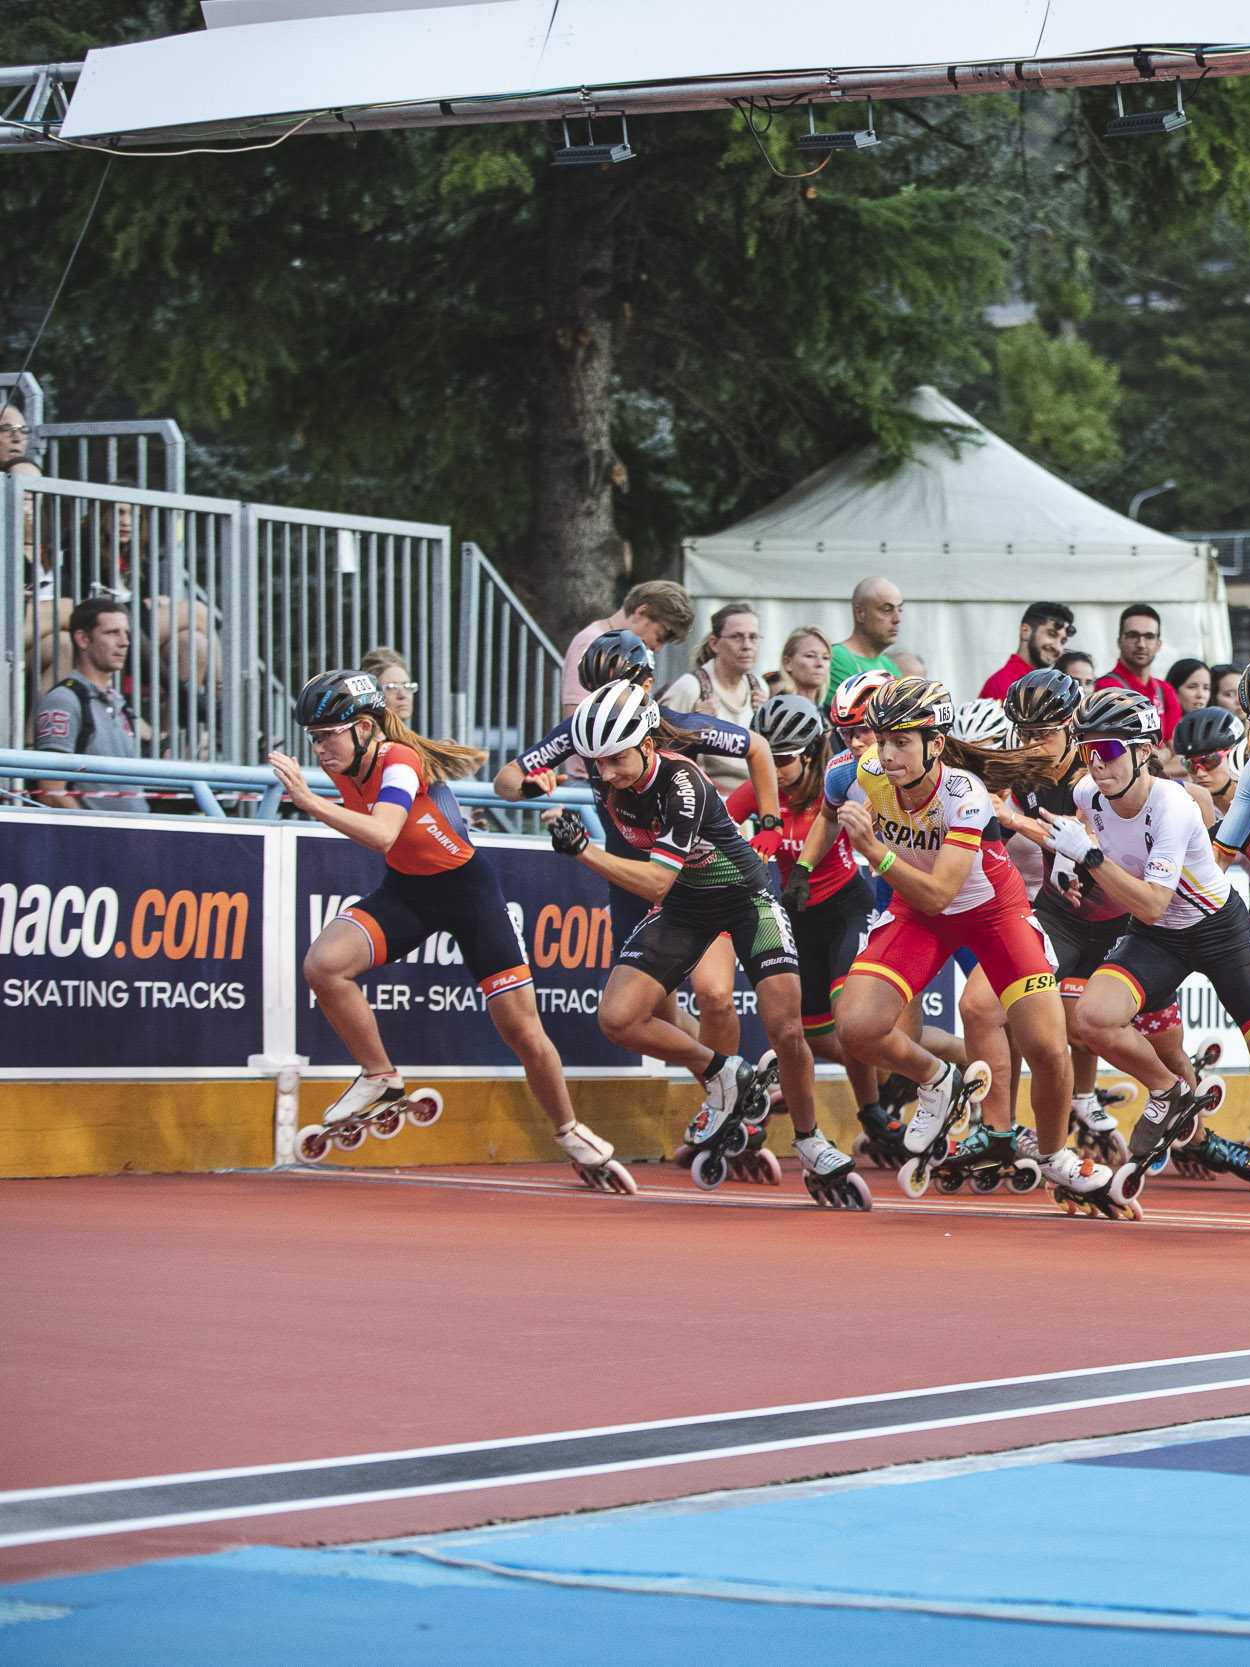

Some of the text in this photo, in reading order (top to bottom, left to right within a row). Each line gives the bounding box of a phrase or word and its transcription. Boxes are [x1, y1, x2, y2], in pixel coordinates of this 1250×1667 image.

[938, 707, 950, 722] 165
[523, 733, 572, 773] FRANCE
[701, 729, 746, 754] FRANCE
[671, 769, 696, 819] Hungary
[427, 824, 461, 856] DAIKIN
[3, 978, 246, 1010] SKATING TRACKS
[491, 974, 518, 989] FILA
